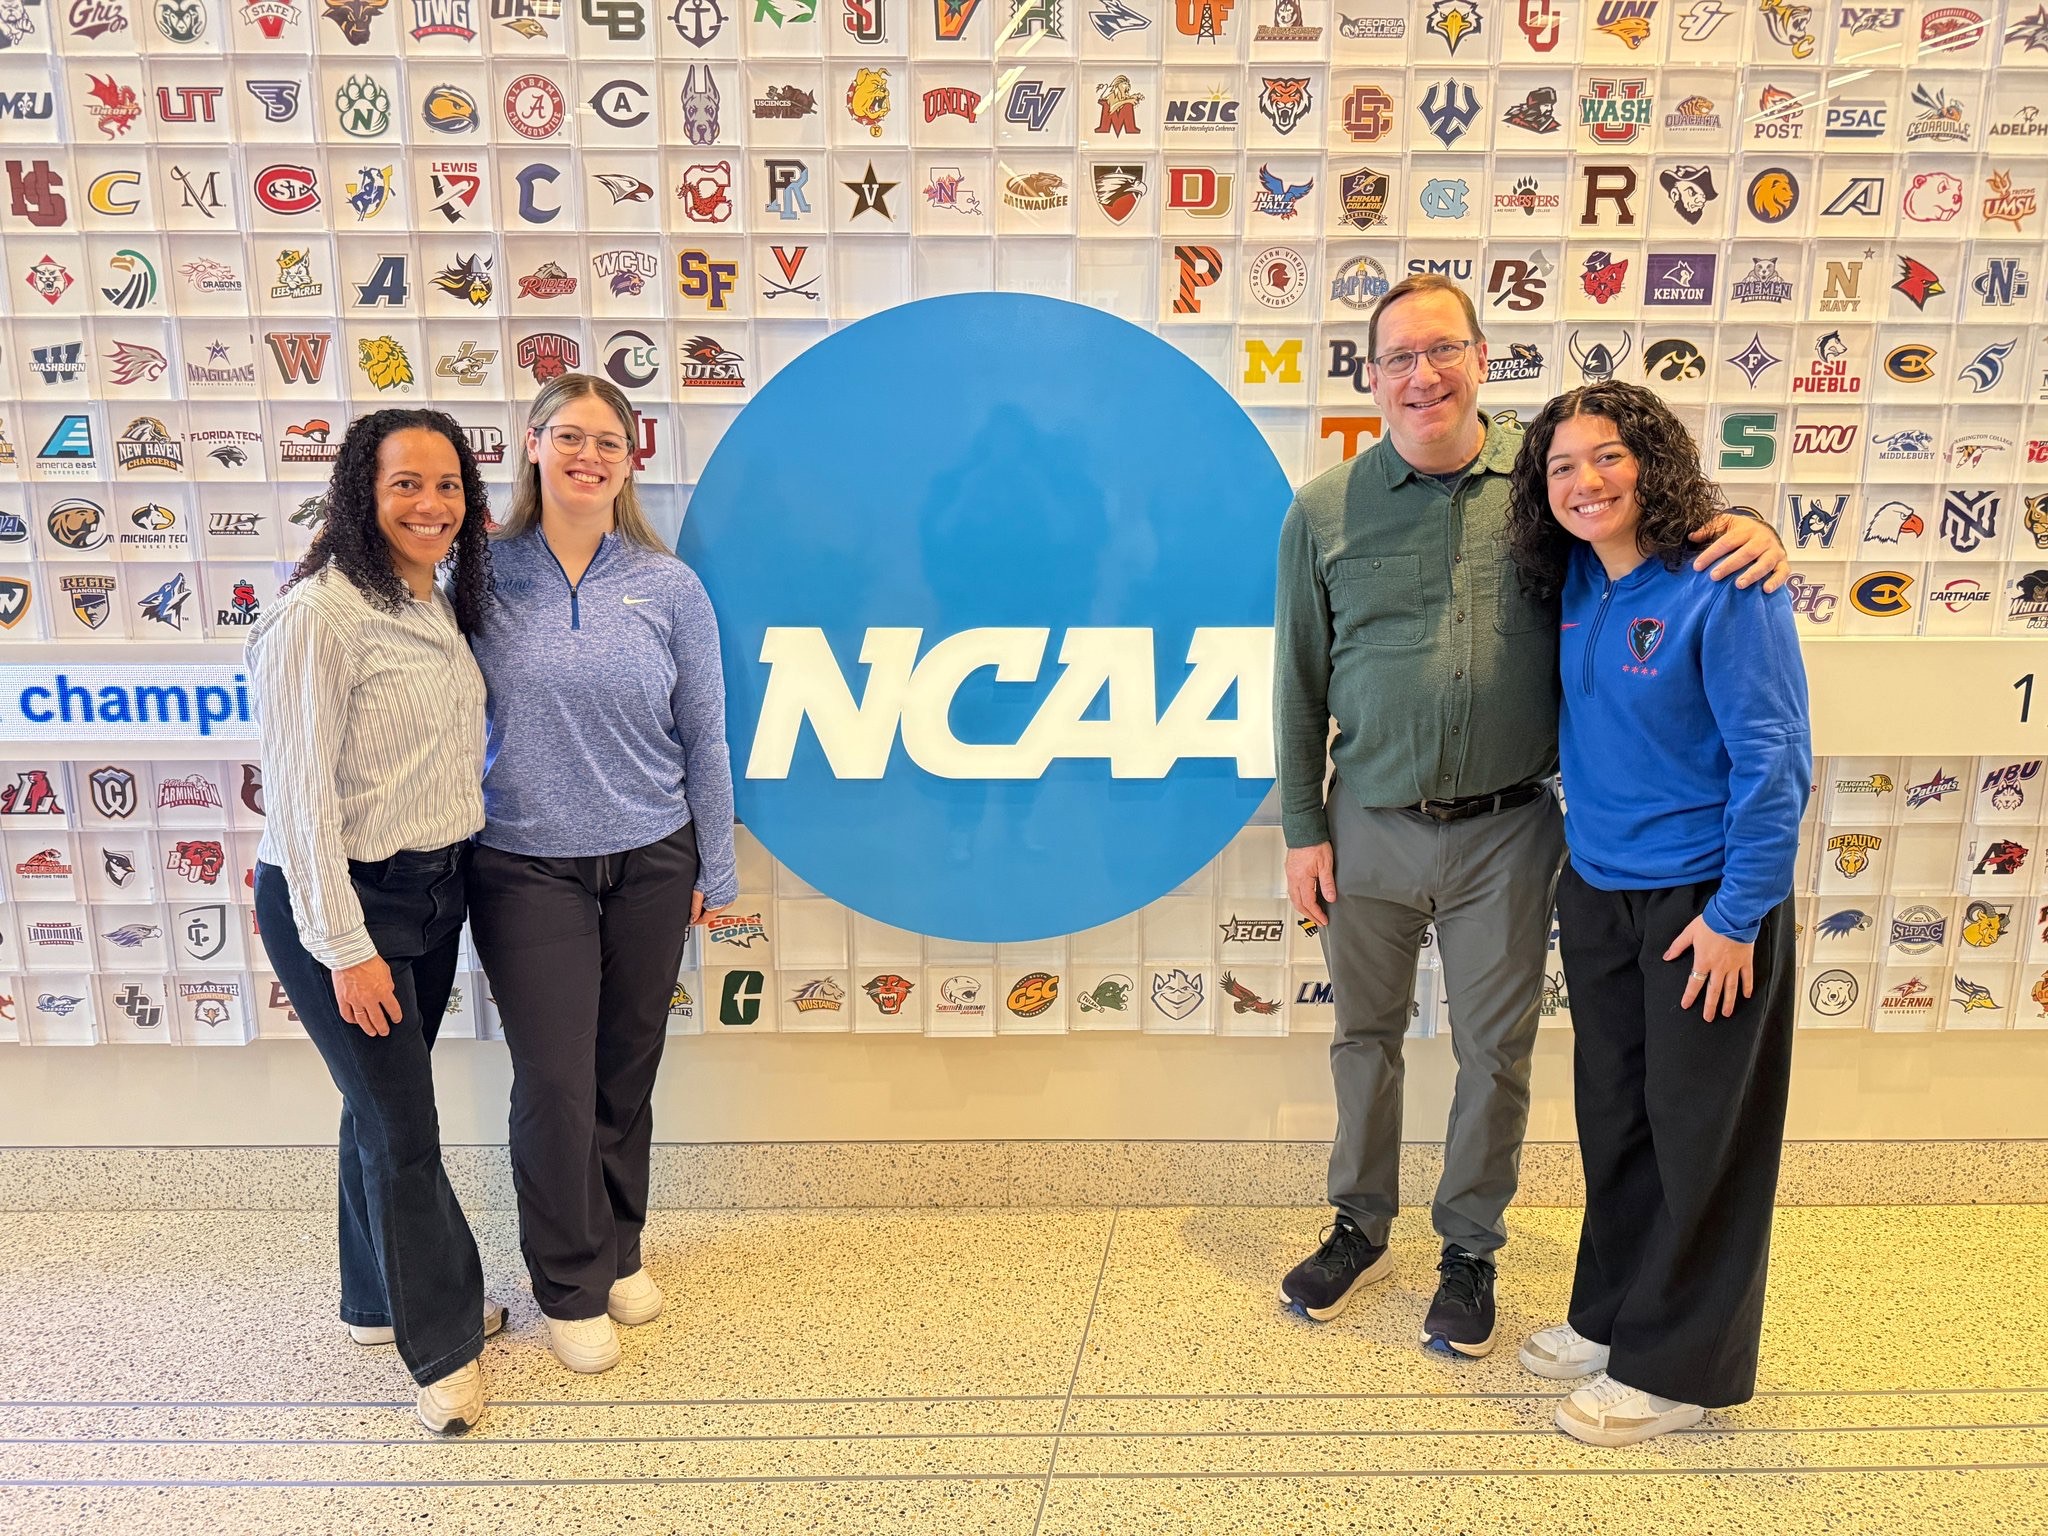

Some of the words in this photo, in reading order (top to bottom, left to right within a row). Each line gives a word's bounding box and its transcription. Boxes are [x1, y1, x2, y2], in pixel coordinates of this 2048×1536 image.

[251, 4, 289, 17] STATE
[413, 0, 471, 29] UWG
[1597, 0, 1658, 26] UNI
[1358, 18, 1404, 27] GEORGIA
[1358, 26, 1404, 34] COLLEGE
[508, 78, 560, 104] ALABAMA
[922, 86, 980, 124] UNLV
[1165, 100, 1240, 122] NSIC
[1580, 97, 1651, 124] WASH
[1826, 109, 1887, 128] PSAC
[1754, 124, 1802, 139] POST
[1906, 121, 1971, 137] CEDARVILLE
[431, 162, 478, 173] LEWIS
[1003, 194, 1068, 212] MILWAUKEE
[1255, 192, 1285, 202] NEW
[1345, 195, 1382, 203] LEHMAN
[1493, 195, 1559, 208] FORESTERS
[1255, 201, 1294, 211] PALTZ
[1983, 195, 2037, 221] UMSL
[592, 250, 657, 278] WCU
[1253, 250, 1280, 287] SOUTHERN
[1284, 251, 1305, 287] VIRGINIA
[519, 275, 577, 298] RIDER
[1173, 246, 1223, 314] P
[1653, 288, 1704, 300] KENYON
[1732, 281, 1793, 300] DAEMEN
[1261, 294, 1296, 306] KNIGHTS
[1819, 300, 1861, 312] NAVY
[517, 332, 580, 370] CWU
[30, 362, 86, 372] WASHBURN
[1244, 339, 1303, 384] M
[1811, 360, 1847, 376] CSU
[187, 364, 254, 382] MAGICIANS
[683, 363, 742, 379] UTSA
[1489, 367, 1538, 381] BEACOM
[1793, 377, 1861, 393] PUEBLO
[190, 431, 232, 444] FLORIDA
[234, 431, 263, 444] TECH
[1793, 424, 1858, 454] TWU
[118, 442, 145, 462] NEW
[145, 441, 181, 462] HAVEN
[1879, 452, 1935, 461] MIDDLEBURY
[36, 461, 74, 470] america
[75, 462, 97, 470] east
[127, 456, 178, 470] CHARGERS
[208, 513, 257, 532] UIS
[120, 534, 166, 543] MICHIGAN
[60, 575, 116, 590] REGIS
[1930, 591, 1991, 602] CARTHAGE
[19, 674, 251, 736] champi
[745, 626, 1276, 781] NCAA
[1836, 780, 1871, 788] FELICIAN
[1981, 760, 2043, 793] HBU
[158, 783, 223, 808] FARMINGTON
[1908, 779, 1960, 801] Patriots
[1827, 833, 1882, 851] DEPAUW
[166, 850, 203, 883] BSU
[707, 917, 762, 930] COAST
[1891, 921, 1944, 942] SLIAC
[27, 927, 83, 941] LANDMARK
[710, 926, 764, 943] COAST
[1234, 925, 1282, 941] ECC
[180, 983, 239, 996] NAZARETH
[1007, 976, 1059, 1010] GSC
[113, 983, 164, 1029] JCU
[798, 999, 841, 1012] MUSTANGS
[1881, 997, 1934, 1009] ALVERNIA
